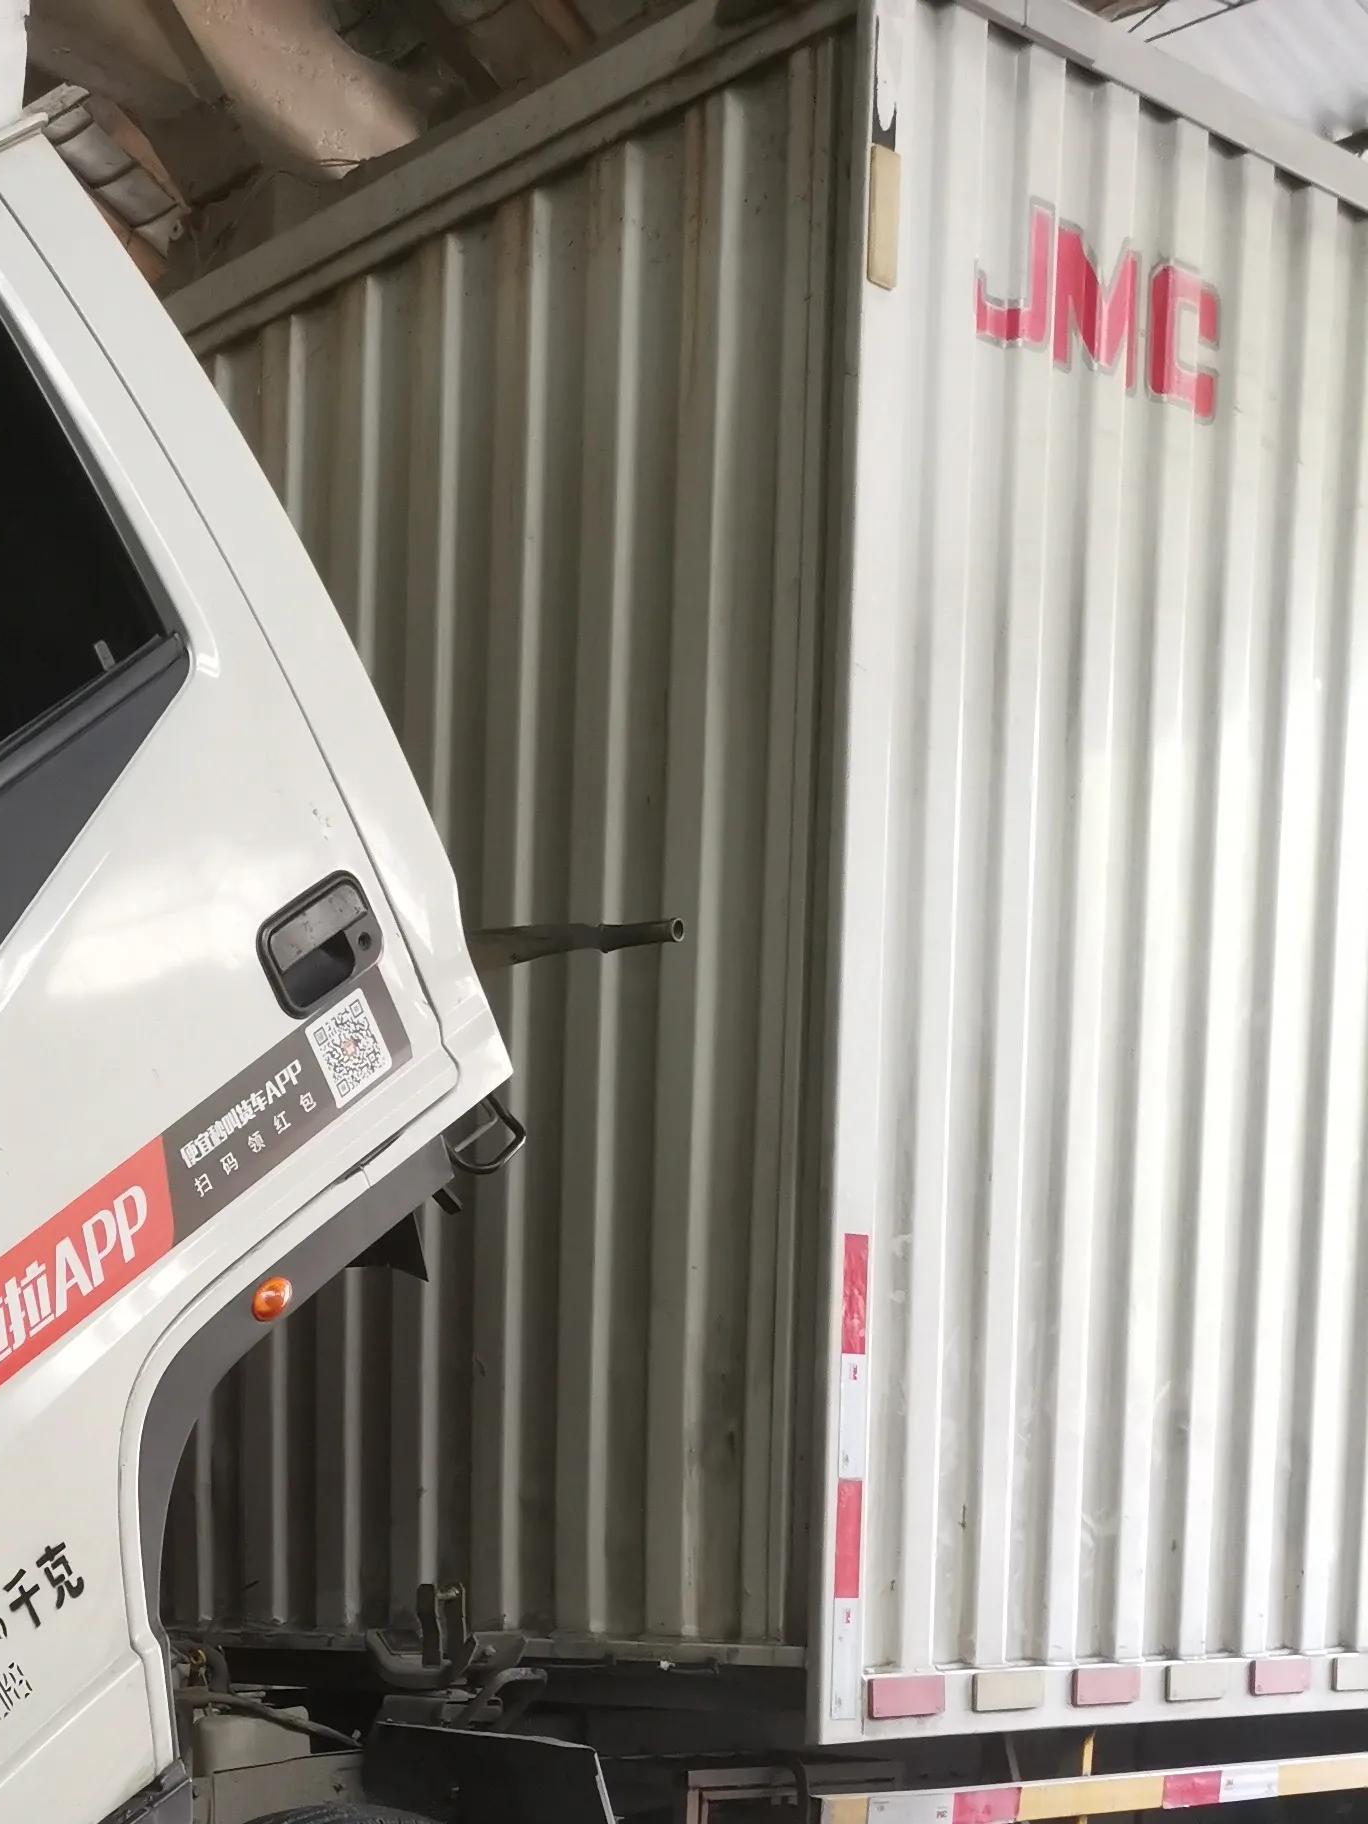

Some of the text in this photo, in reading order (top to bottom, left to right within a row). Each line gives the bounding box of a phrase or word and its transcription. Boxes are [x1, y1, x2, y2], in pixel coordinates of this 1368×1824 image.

[974, 195, 1220, 425] JMC
[180, 1059, 302, 1169] 便宜秒叫货车APP
[194, 1092, 317, 1198] 扫码领红包
